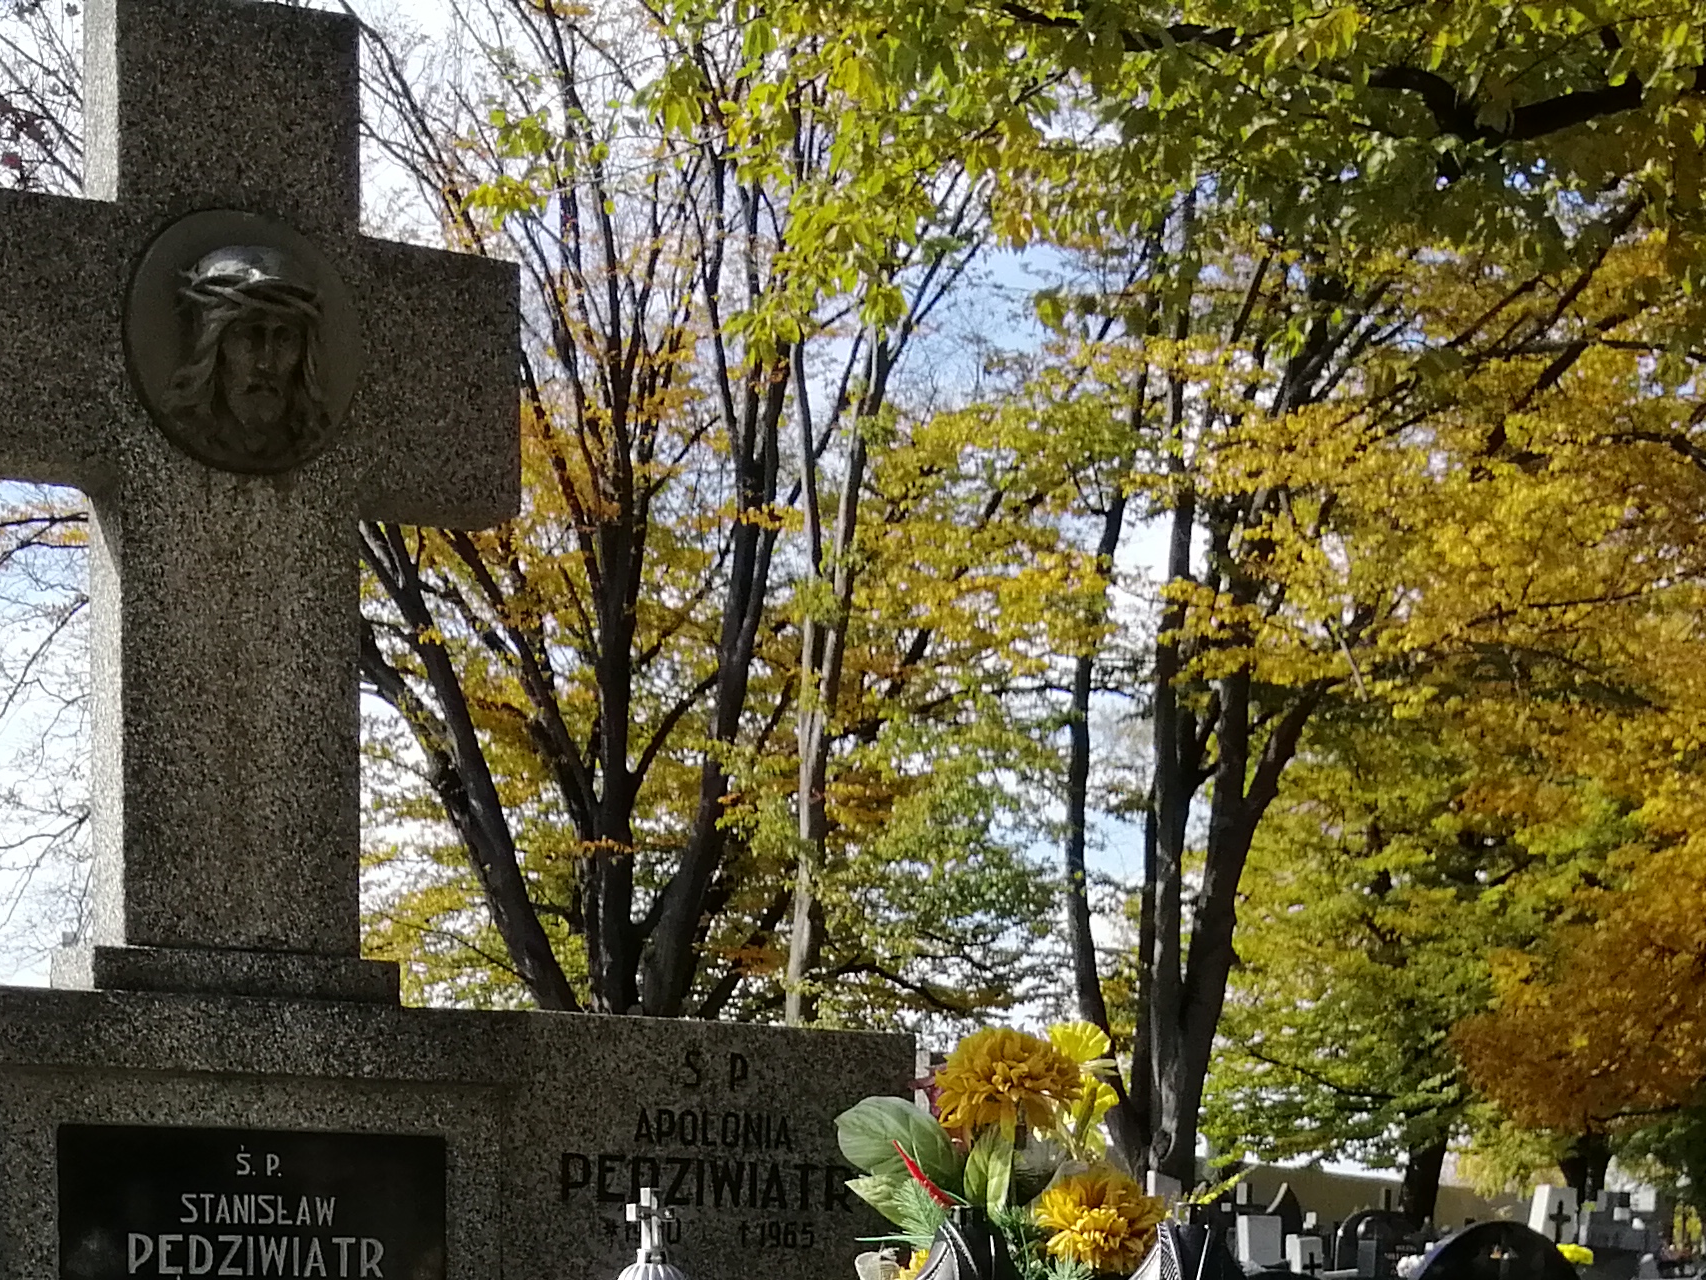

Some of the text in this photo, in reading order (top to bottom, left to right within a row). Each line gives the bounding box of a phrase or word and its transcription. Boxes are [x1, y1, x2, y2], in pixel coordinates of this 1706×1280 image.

[634, 1107, 793, 1150] APOLONIA
[236, 1145, 282, 1177] Ś. P.
[180, 1193, 336, 1227] STANISŁAW
[758, 1220, 816, 1249] 1965
